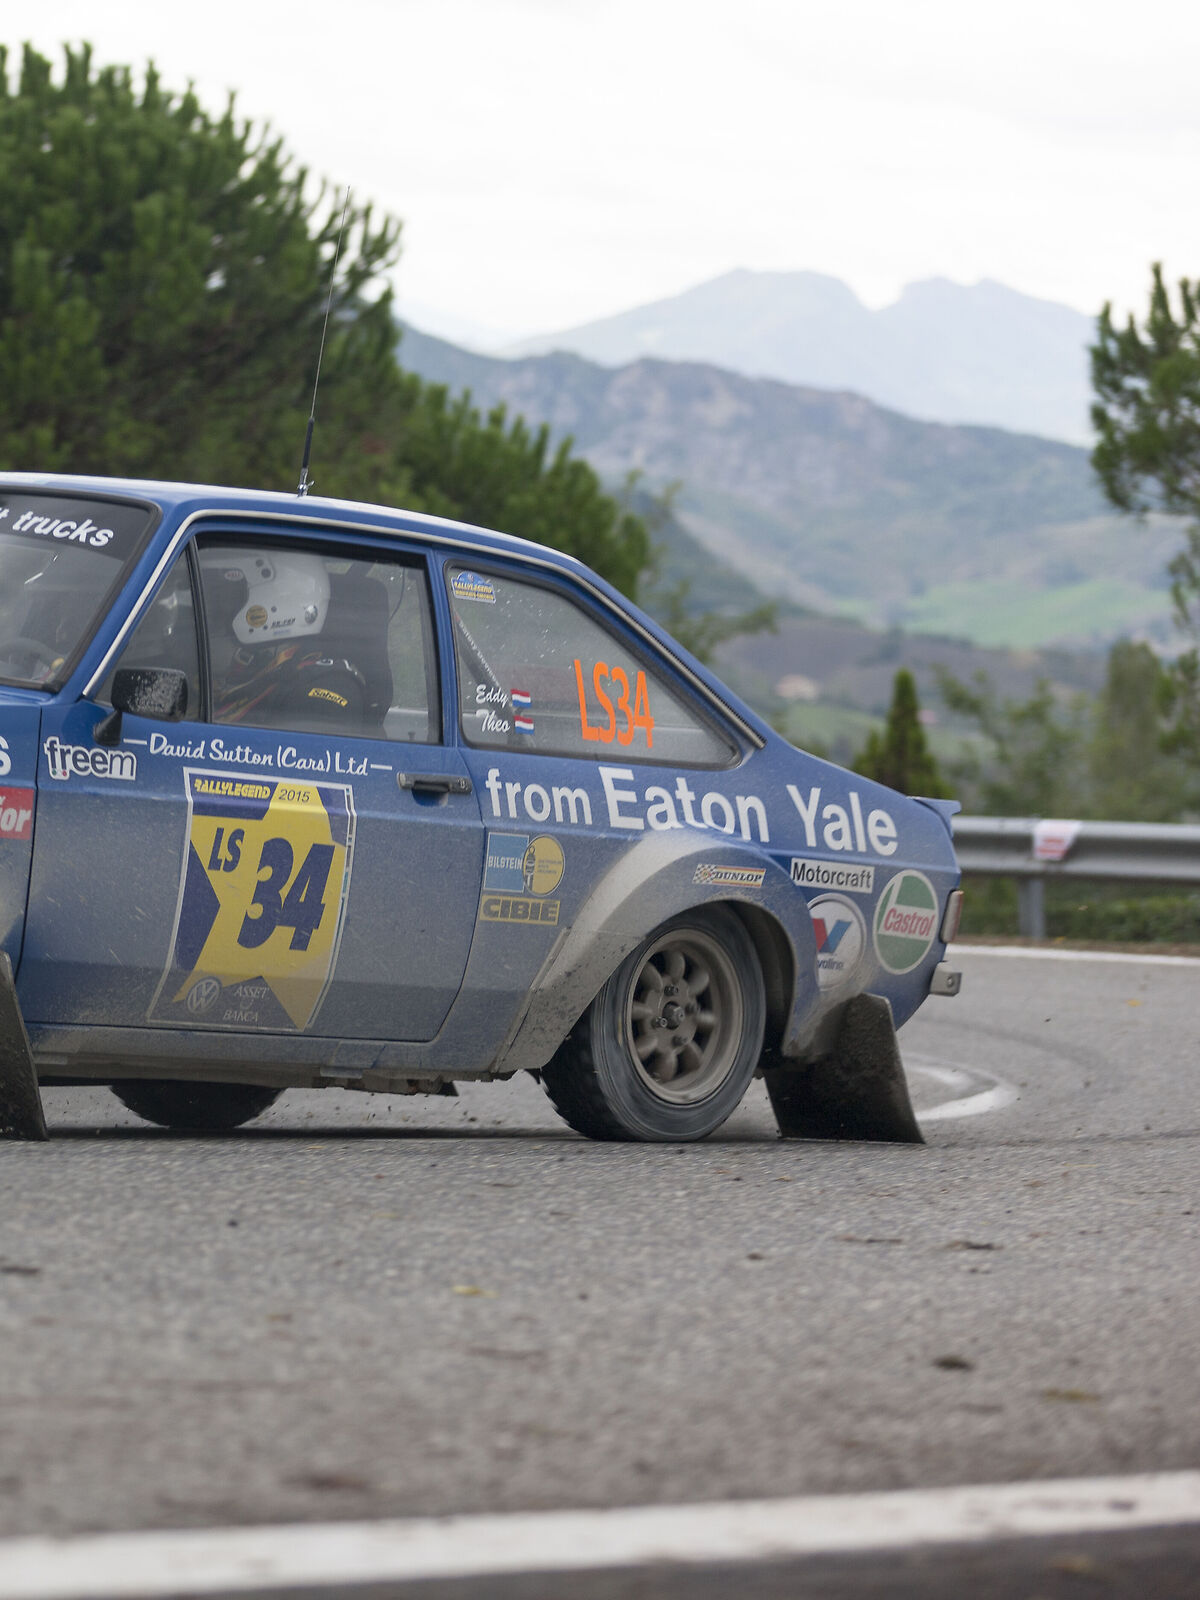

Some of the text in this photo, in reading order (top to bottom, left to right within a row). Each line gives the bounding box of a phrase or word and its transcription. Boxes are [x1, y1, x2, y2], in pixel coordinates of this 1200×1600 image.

[12, 511, 115, 547] trucks
[475, 684, 509, 708] Eddy
[573, 659, 655, 748] LS34
[475, 709, 510, 733] Theo
[45, 738, 136, 778] freem
[149, 733, 369, 776] David Sutton (Cars) Ltd
[194, 778, 311, 804] RALLYLEGEND 2015
[485, 766, 898, 856] from Eaton Yale
[487, 856, 523, 870] BILSTEIN
[714, 871, 762, 882] DUNLOP
[792, 862, 872, 888] Motorcraft
[207, 826, 335, 951] LS 34
[482, 898, 558, 922] CIBIE
[884, 907, 935, 937] Castrol
